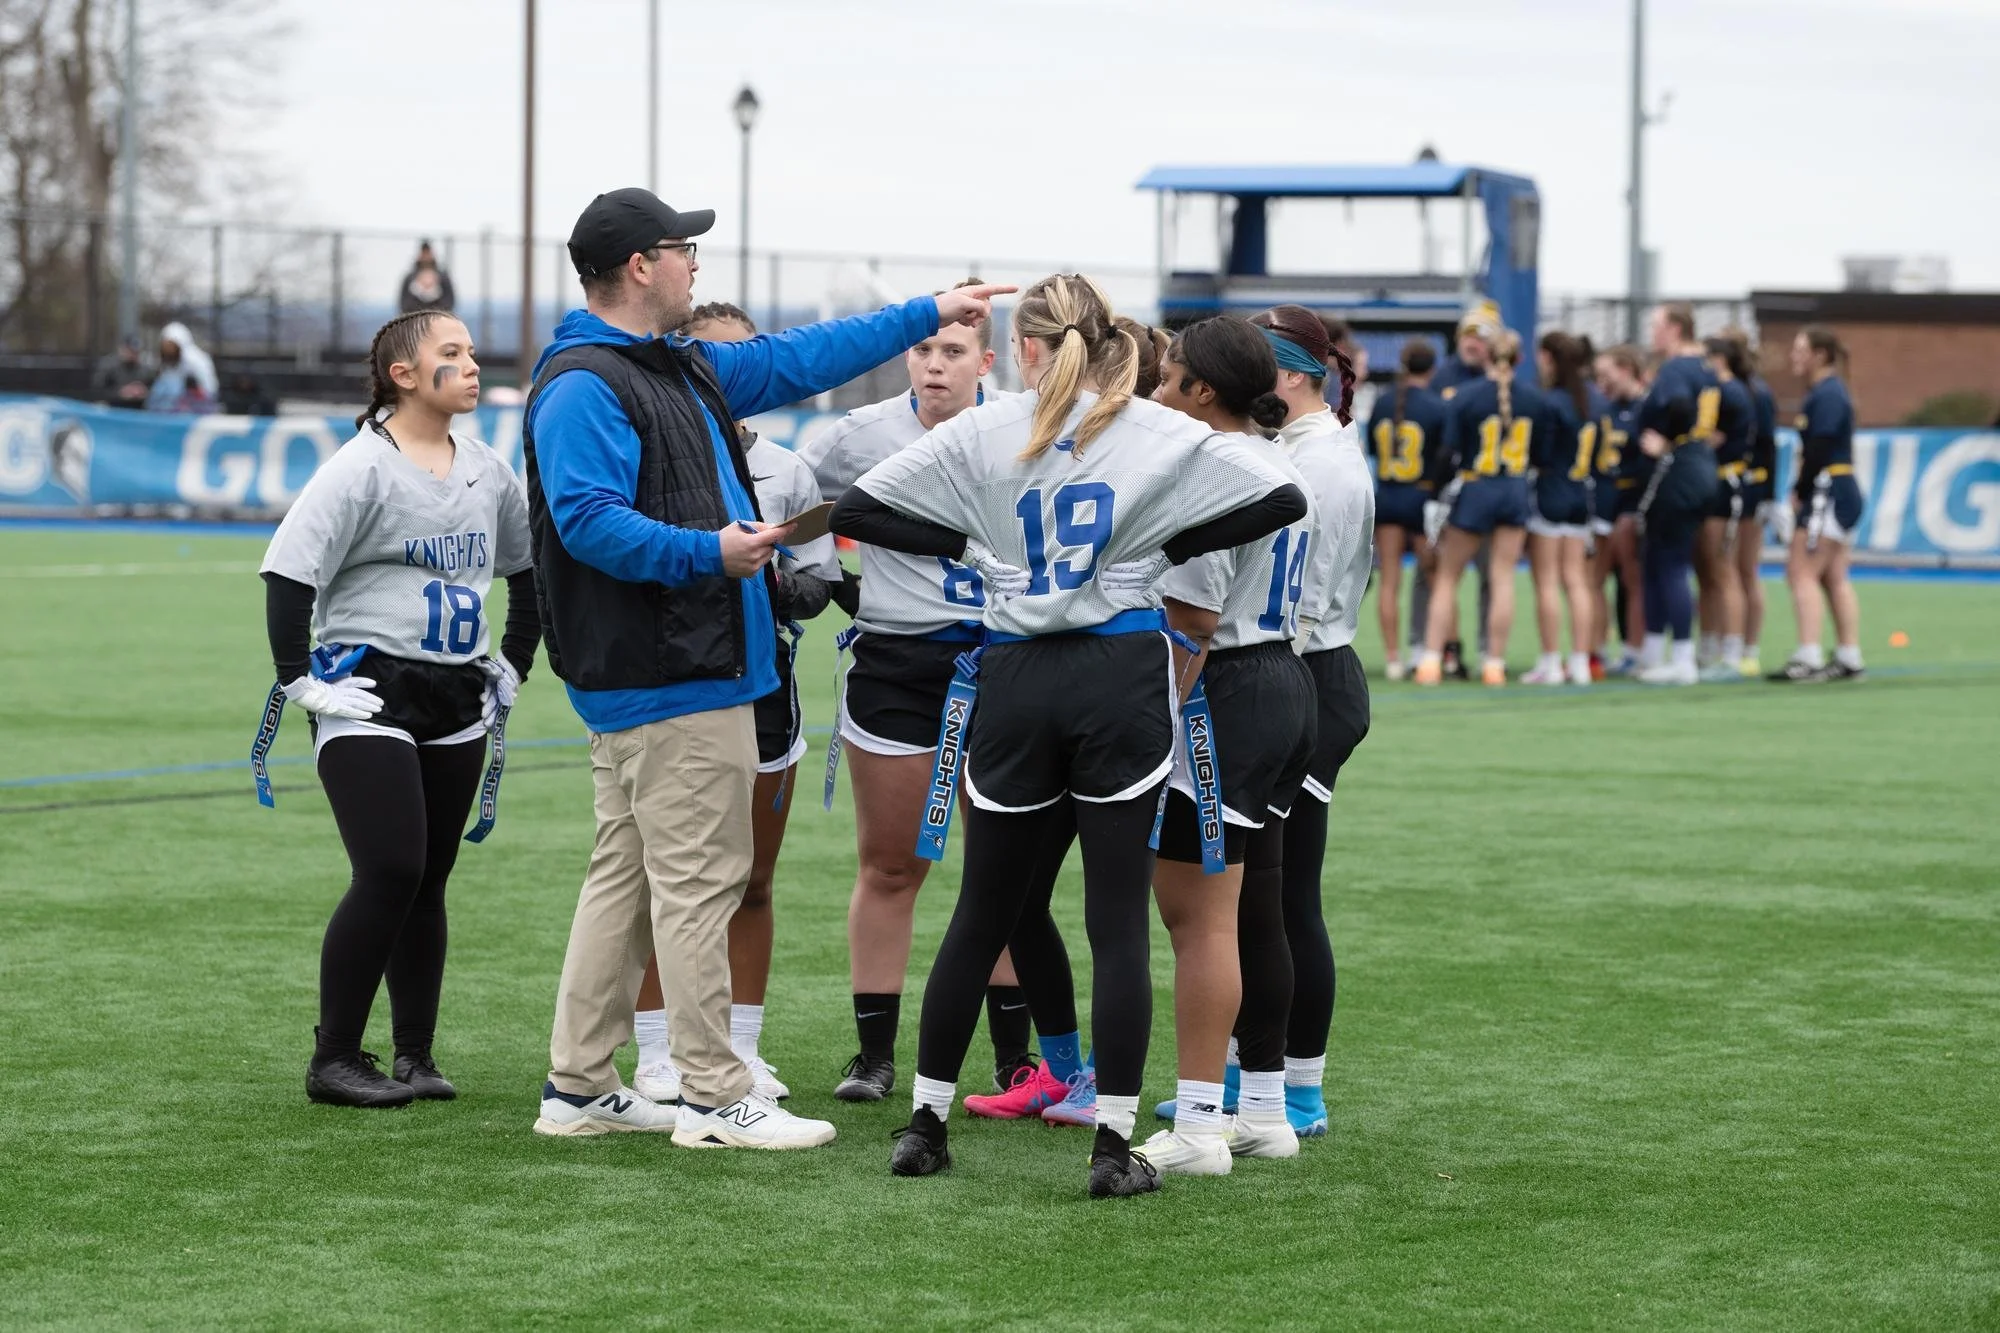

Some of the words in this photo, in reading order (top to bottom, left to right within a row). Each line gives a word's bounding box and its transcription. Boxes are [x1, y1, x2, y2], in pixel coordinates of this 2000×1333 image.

[176, 414, 340, 504] GO
[1373, 417, 1424, 482] 13
[1473, 414, 1533, 476] 14
[404, 532, 487, 571] KNIGHTS
[1015, 481, 1116, 596] 19
[1258, 527, 1309, 633] 14
[420, 579, 482, 655] 18
[251, 682, 286, 778] NIGHTS
[927, 698, 968, 826] KNIGHTS
[1189, 713, 1221, 841] KNIGHTS
